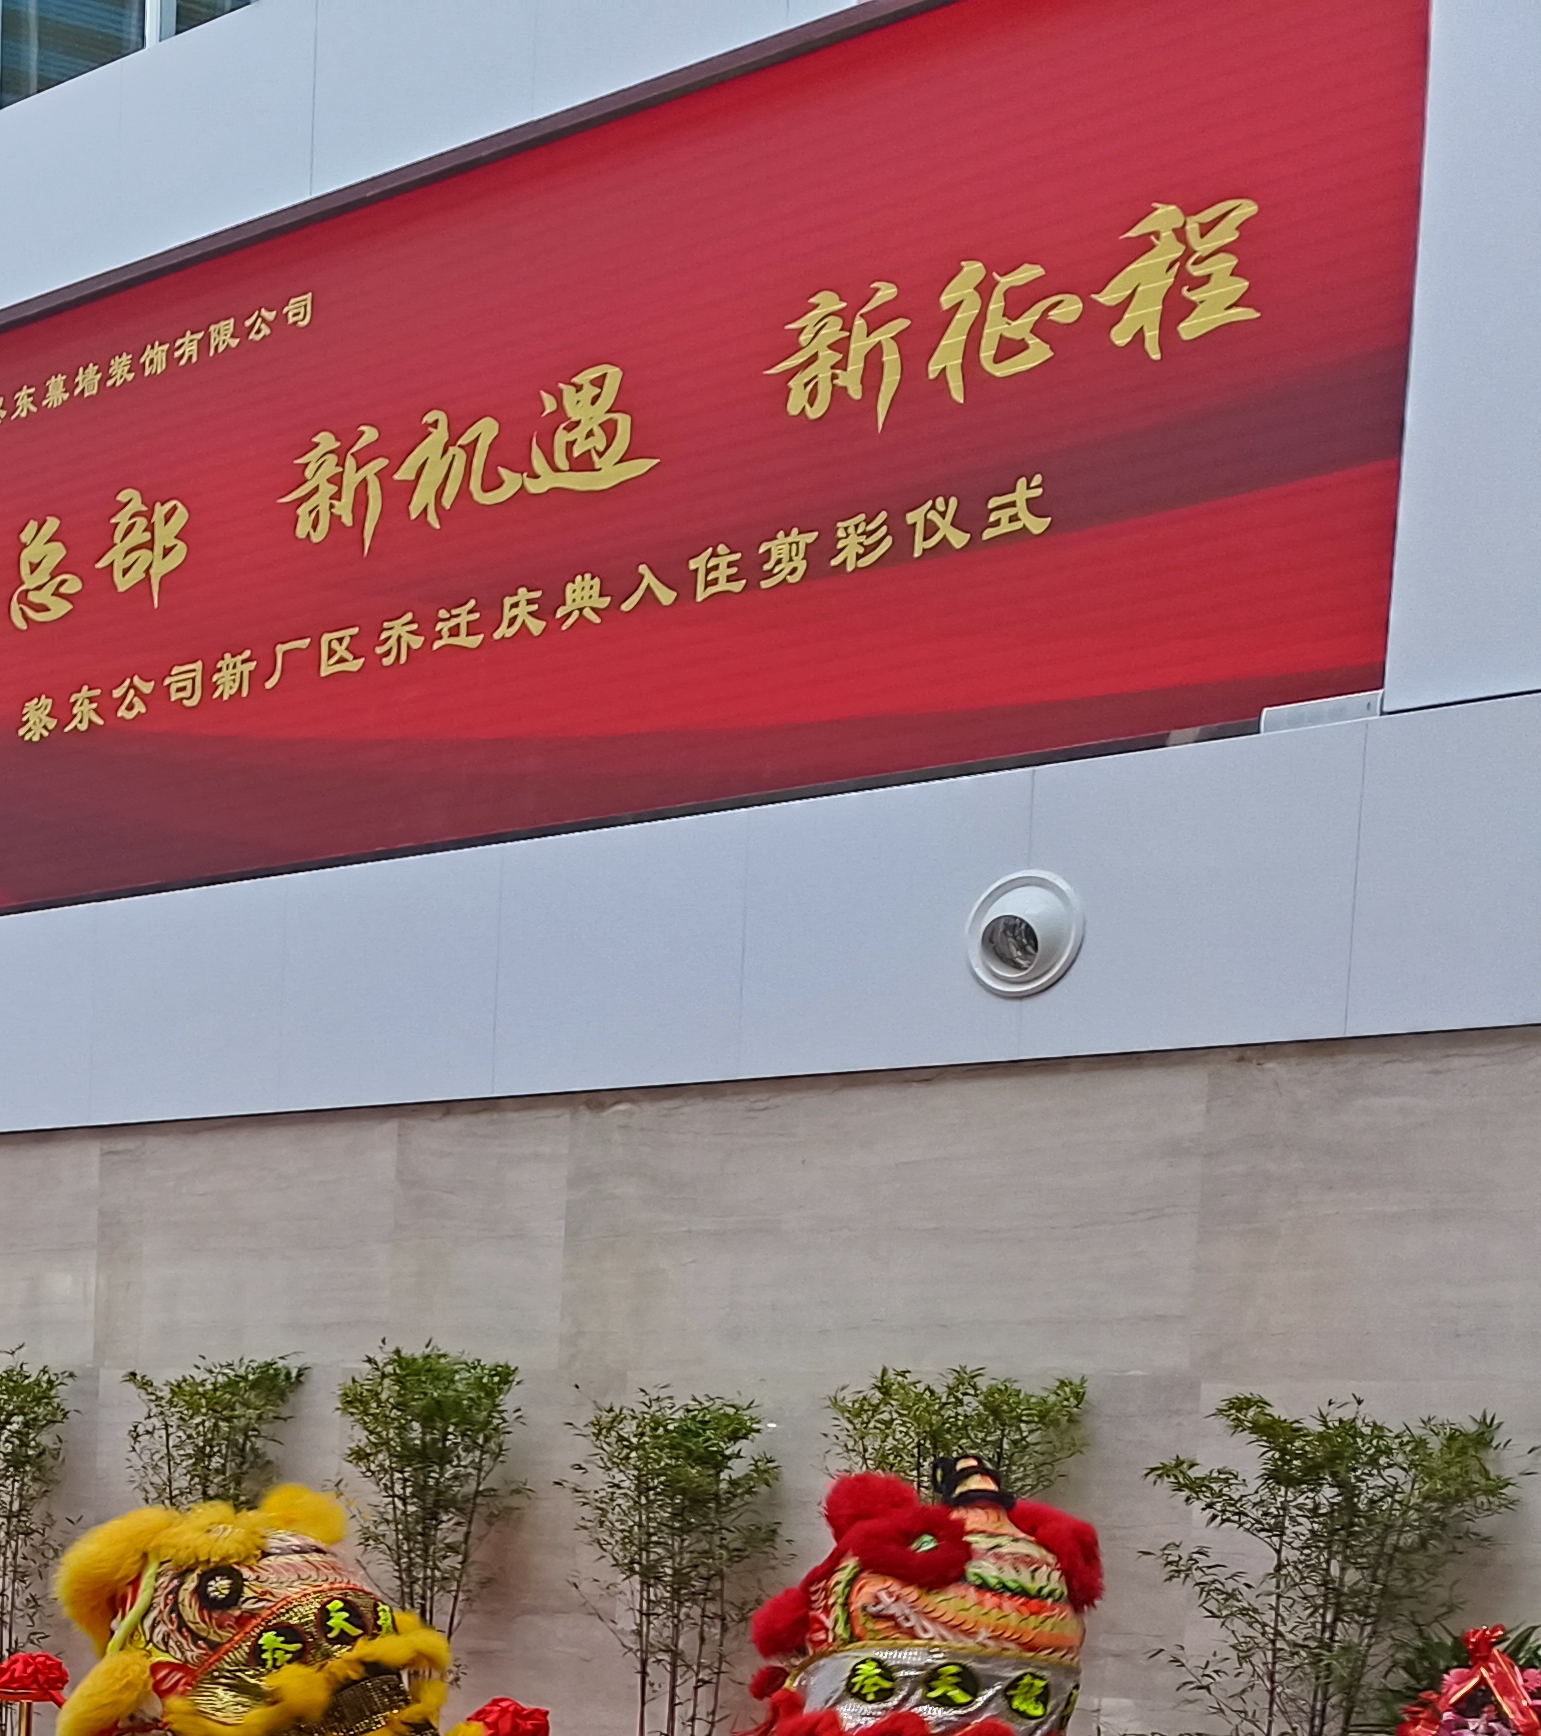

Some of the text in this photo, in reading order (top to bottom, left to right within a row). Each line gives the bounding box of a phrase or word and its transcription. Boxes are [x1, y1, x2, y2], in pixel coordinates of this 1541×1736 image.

[278, 363, 660, 557] 新机遇
[763, 198, 1261, 434] 新征程
[17, 473, 1052, 742] 黎东公司新厂区乔迁庆典入住剪彩仪式
